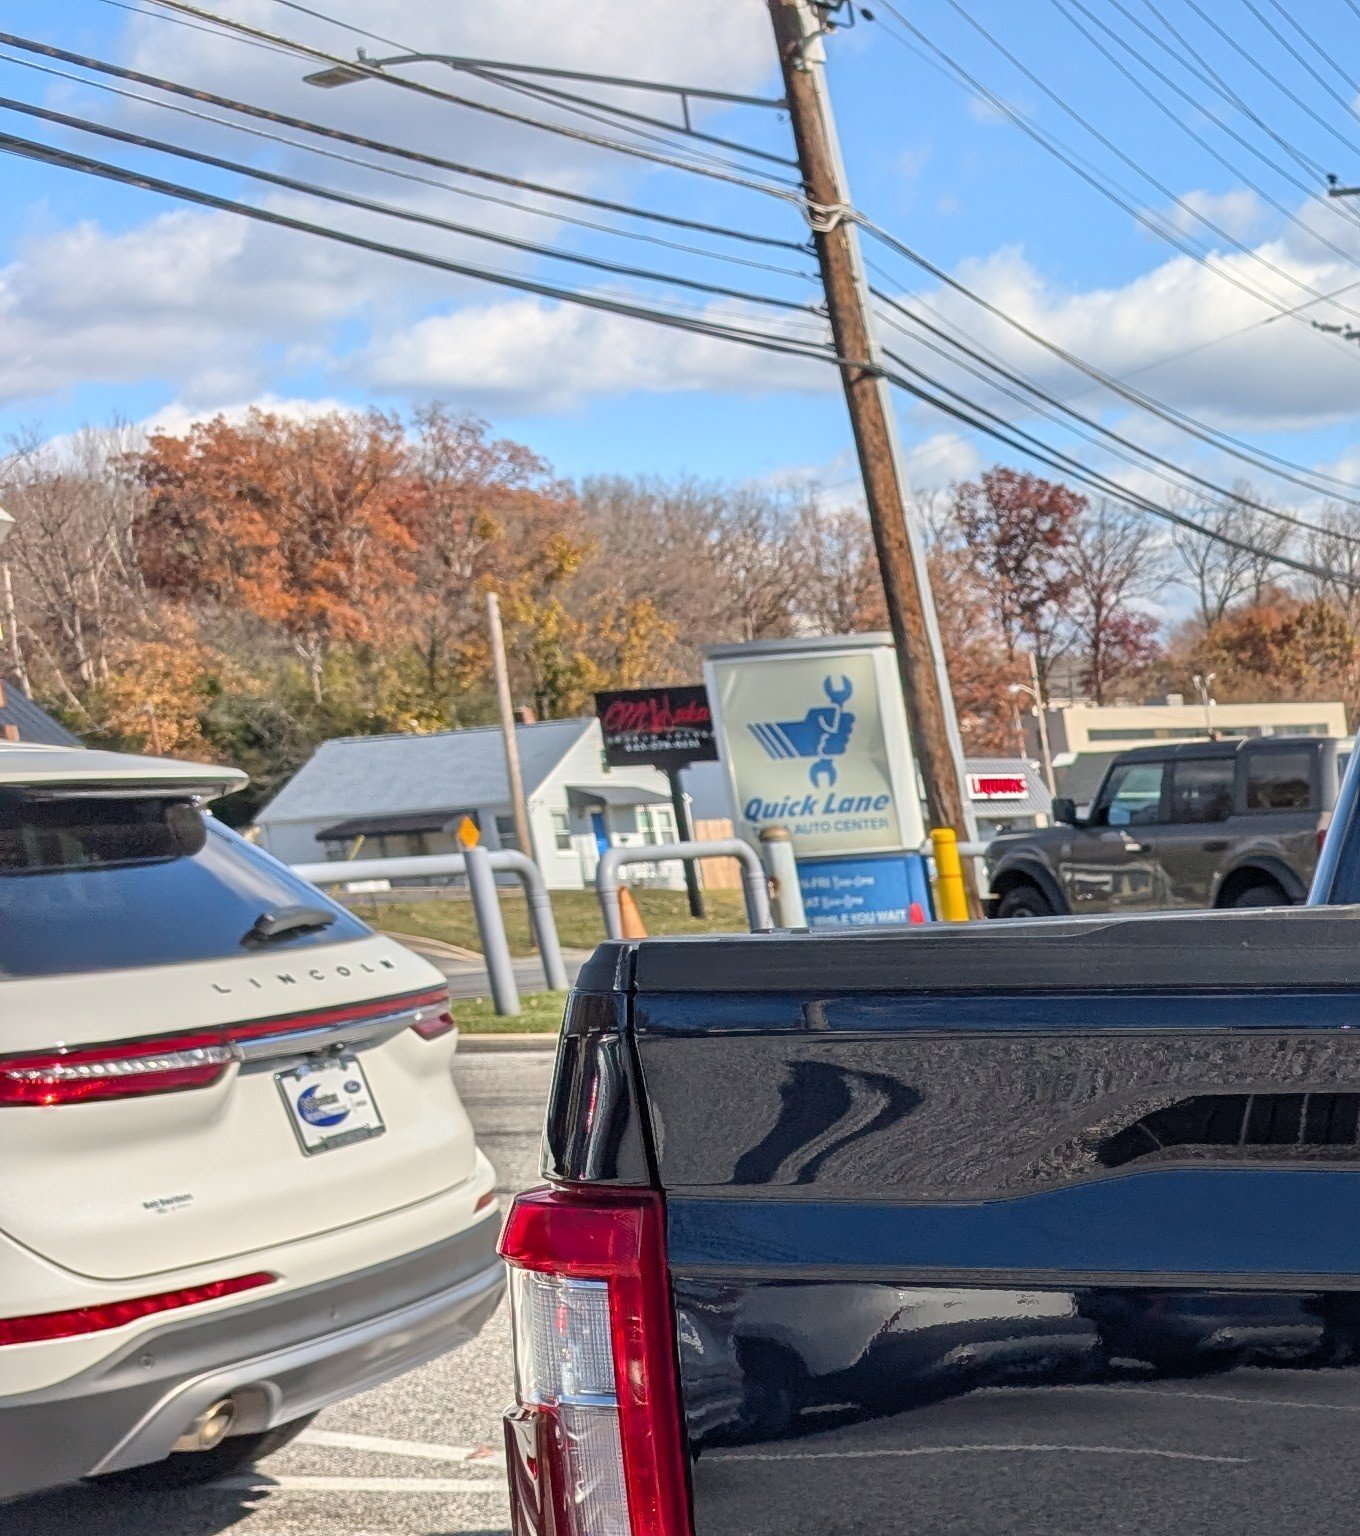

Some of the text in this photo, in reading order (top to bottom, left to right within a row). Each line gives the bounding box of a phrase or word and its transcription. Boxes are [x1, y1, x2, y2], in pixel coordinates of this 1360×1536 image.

[744, 792, 890, 822] Quick Lane
[794, 821, 831, 835] AUTO
[833, 817, 890, 832] CENTER
[851, 911, 876, 924] YOU
[877, 908, 906, 922] WAIT
[211, 959, 395, 994] LINCOLN
